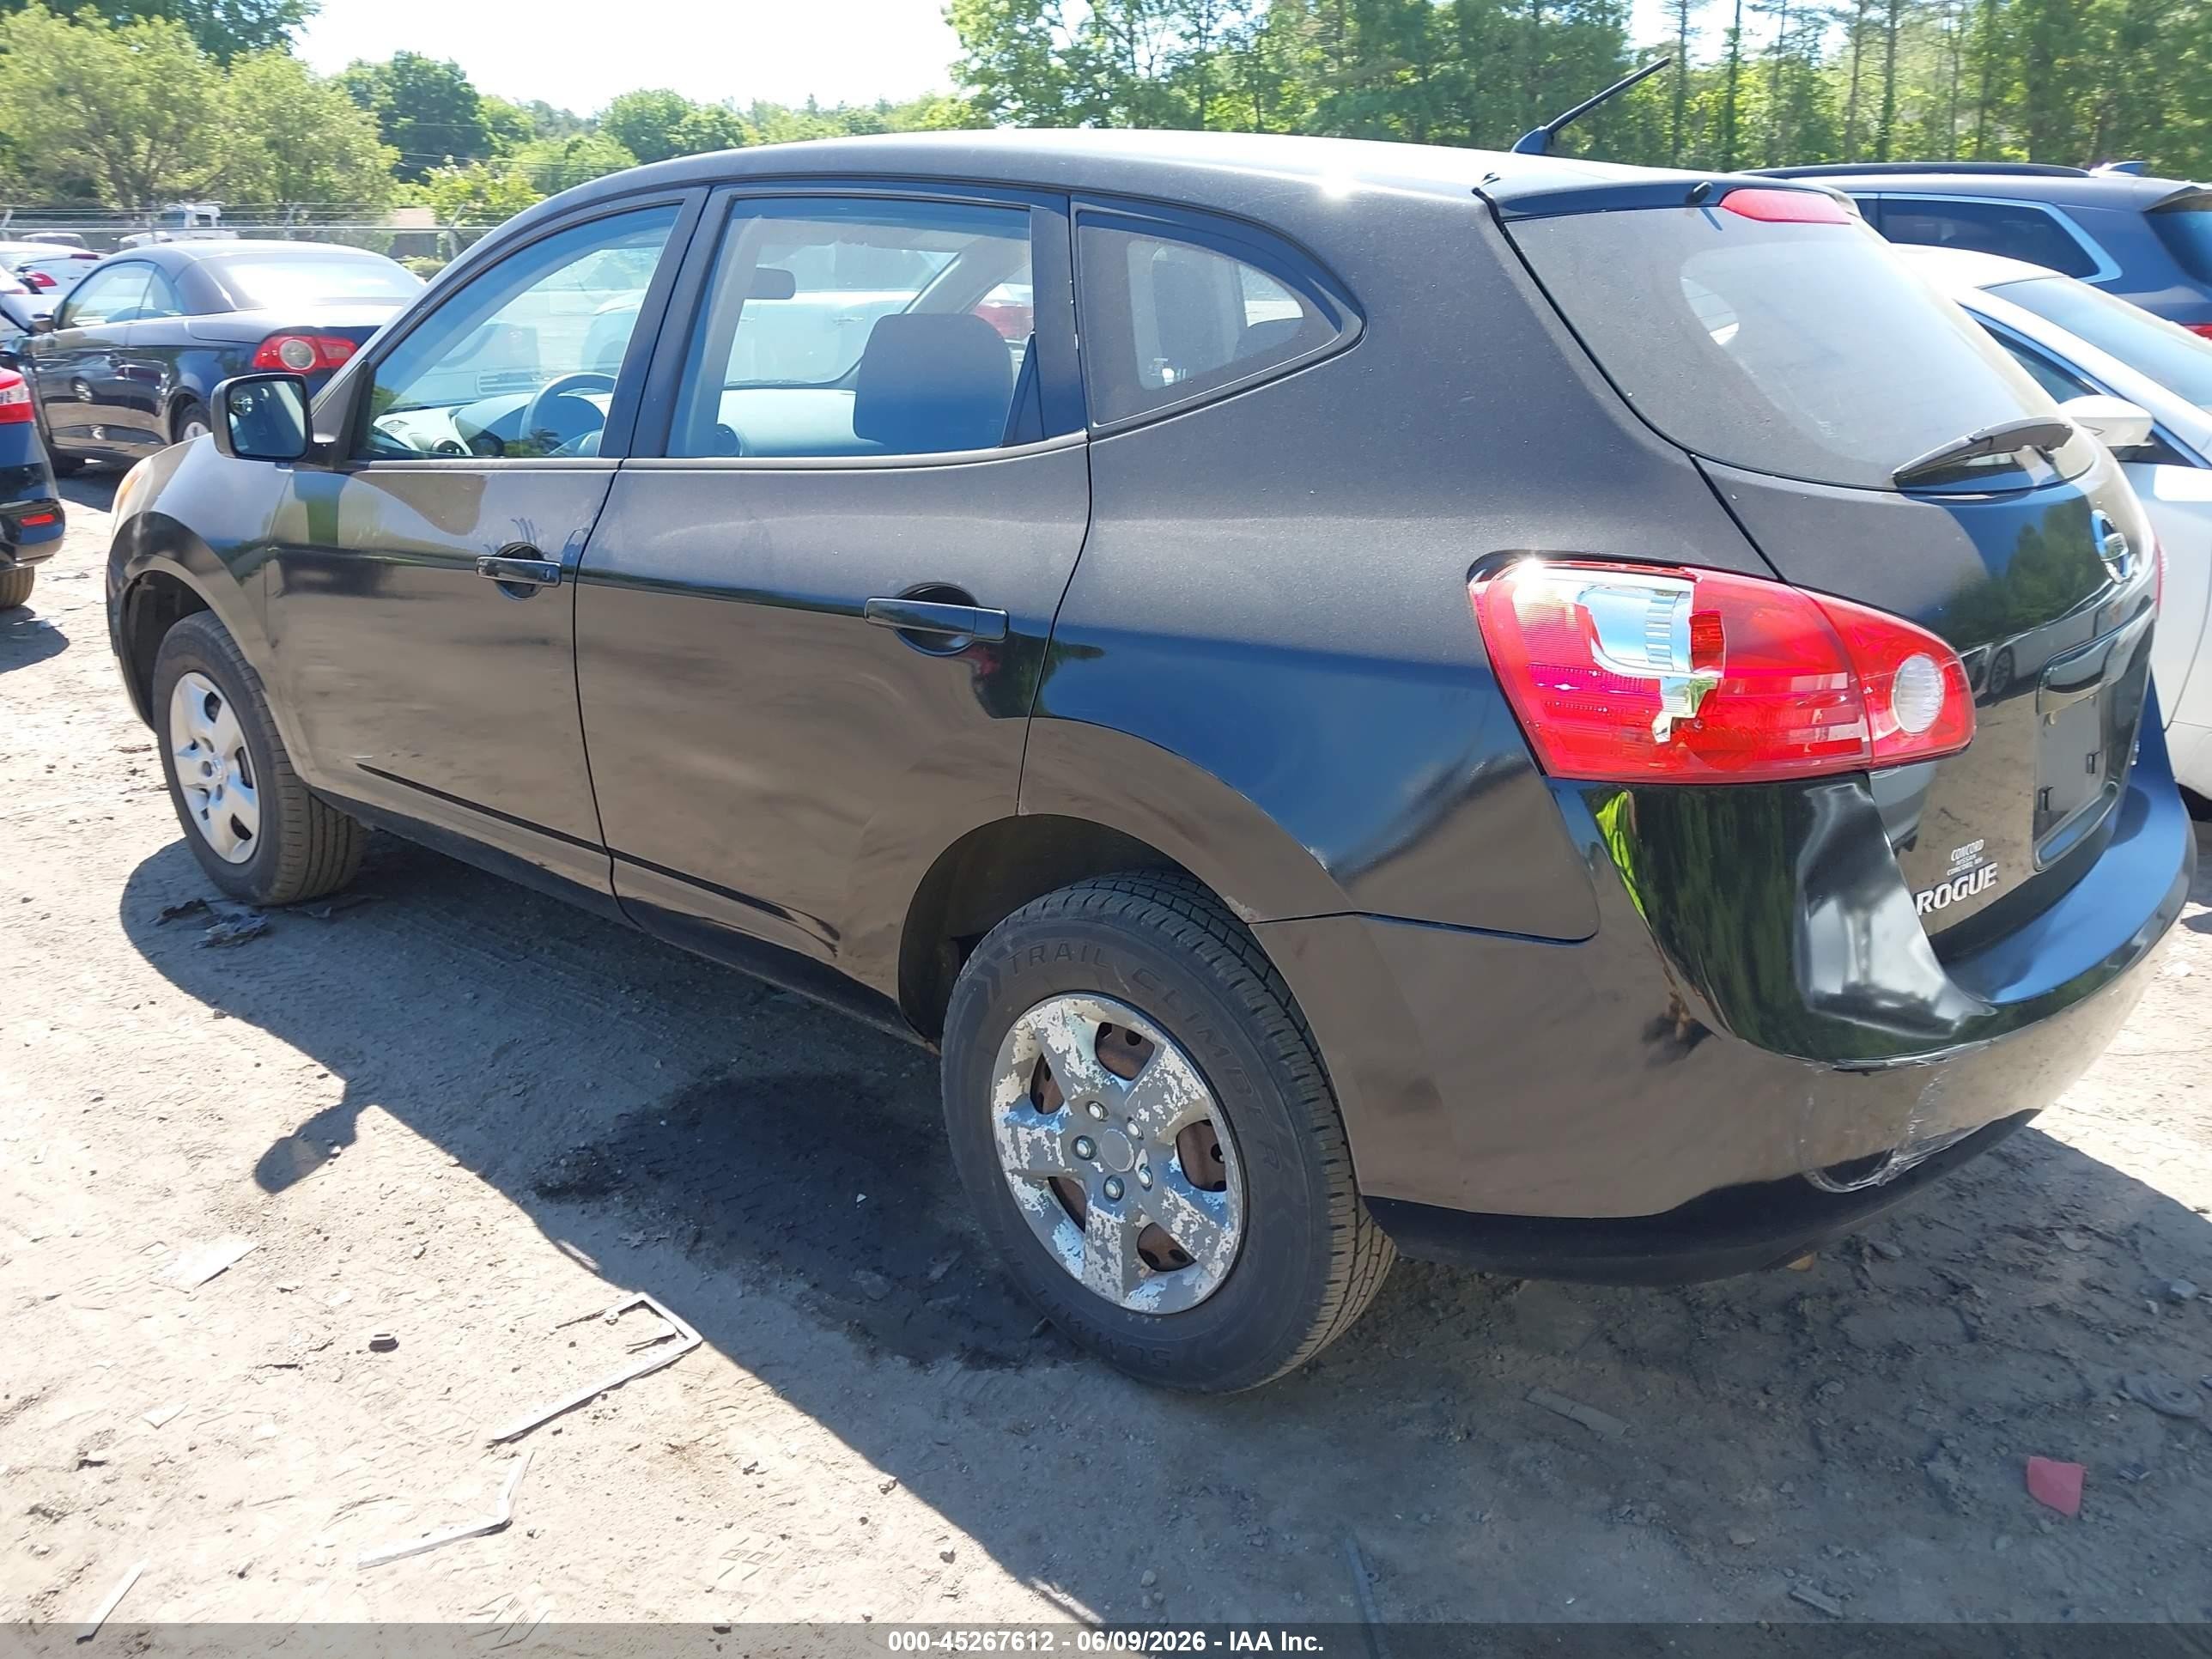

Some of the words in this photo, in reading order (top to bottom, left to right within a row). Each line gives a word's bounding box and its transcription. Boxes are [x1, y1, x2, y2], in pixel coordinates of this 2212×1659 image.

[1916, 862, 1998, 916] ROGUE
[1003, 939, 1110, 975] TRAIL
[1131, 968, 1283, 1171] CLIMBER
